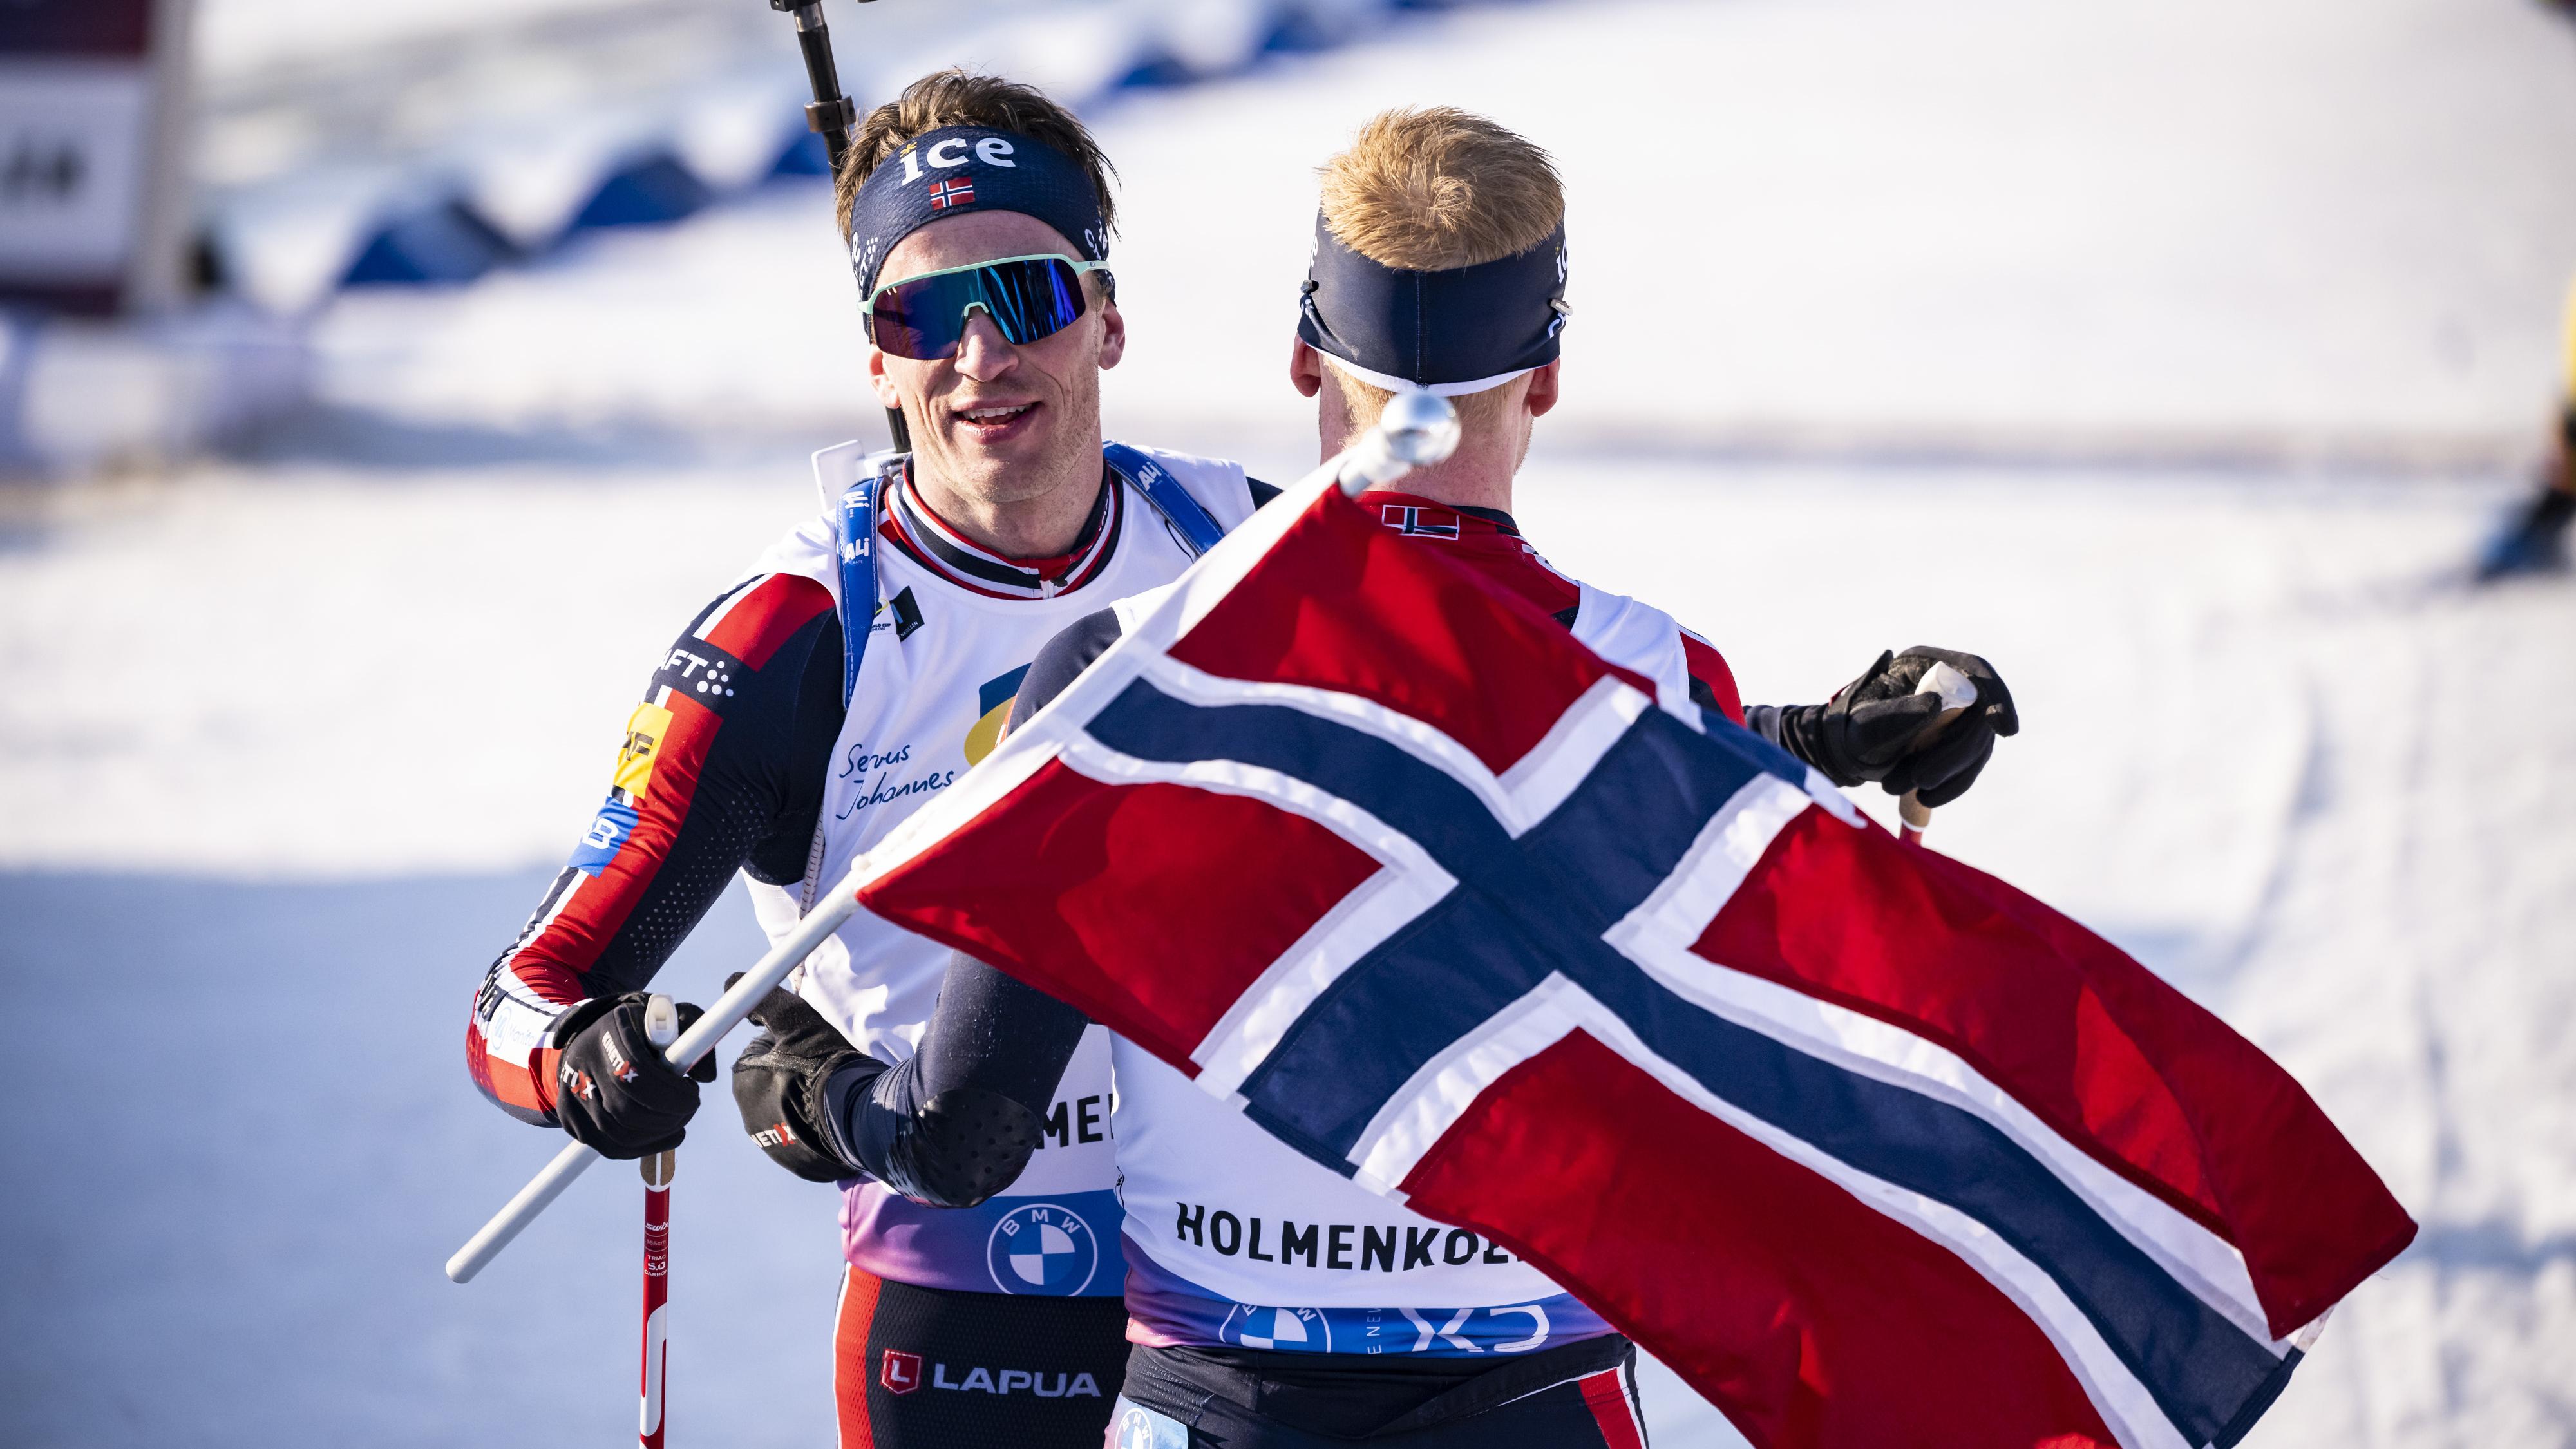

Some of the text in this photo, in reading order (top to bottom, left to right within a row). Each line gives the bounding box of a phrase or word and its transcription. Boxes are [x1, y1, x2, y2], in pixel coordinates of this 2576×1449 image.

[900, 137, 1016, 186] ice
[839, 743, 911, 778] Servus
[836, 770, 954, 820] Johannes
[1001, 1209, 1081, 1237] BMW
[934, 1363, 1102, 1398] LAPUA
